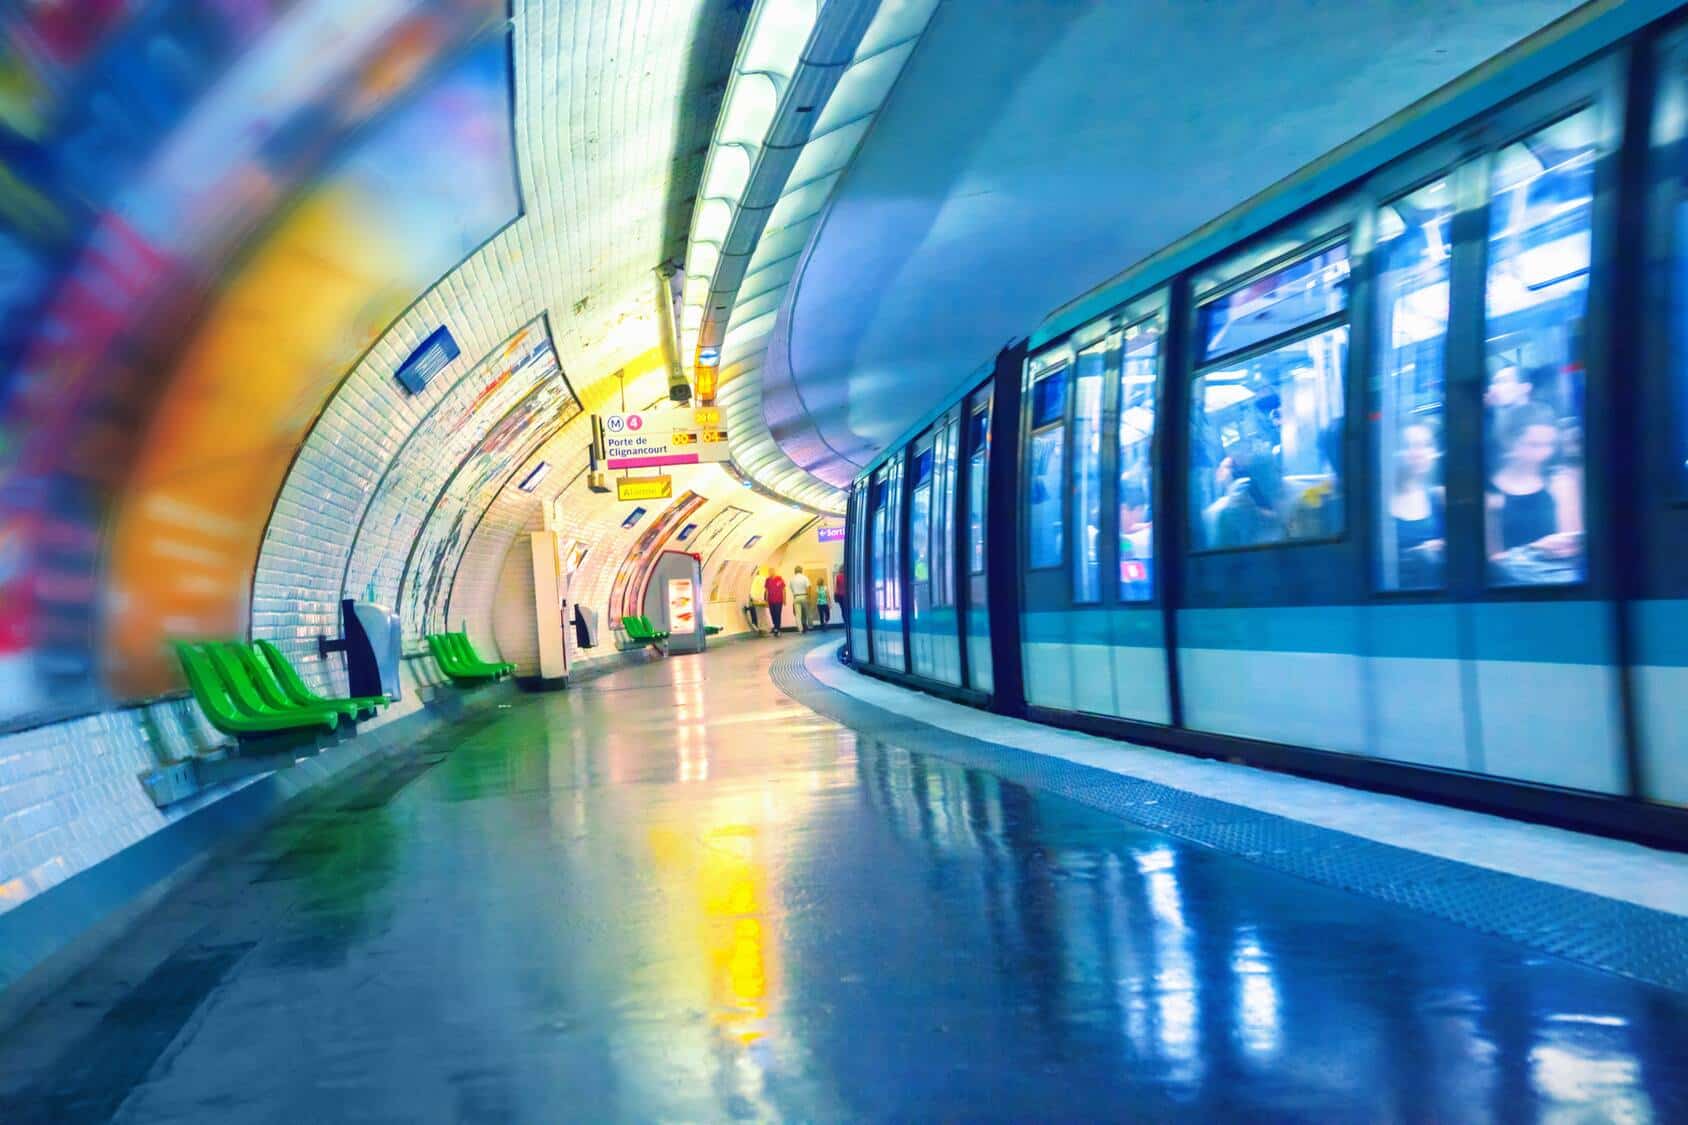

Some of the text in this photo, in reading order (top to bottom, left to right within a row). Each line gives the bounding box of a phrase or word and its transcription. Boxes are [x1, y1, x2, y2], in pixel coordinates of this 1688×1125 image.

[608, 436, 647, 447] Porte de
[609, 445, 667, 457] Clignancourt
